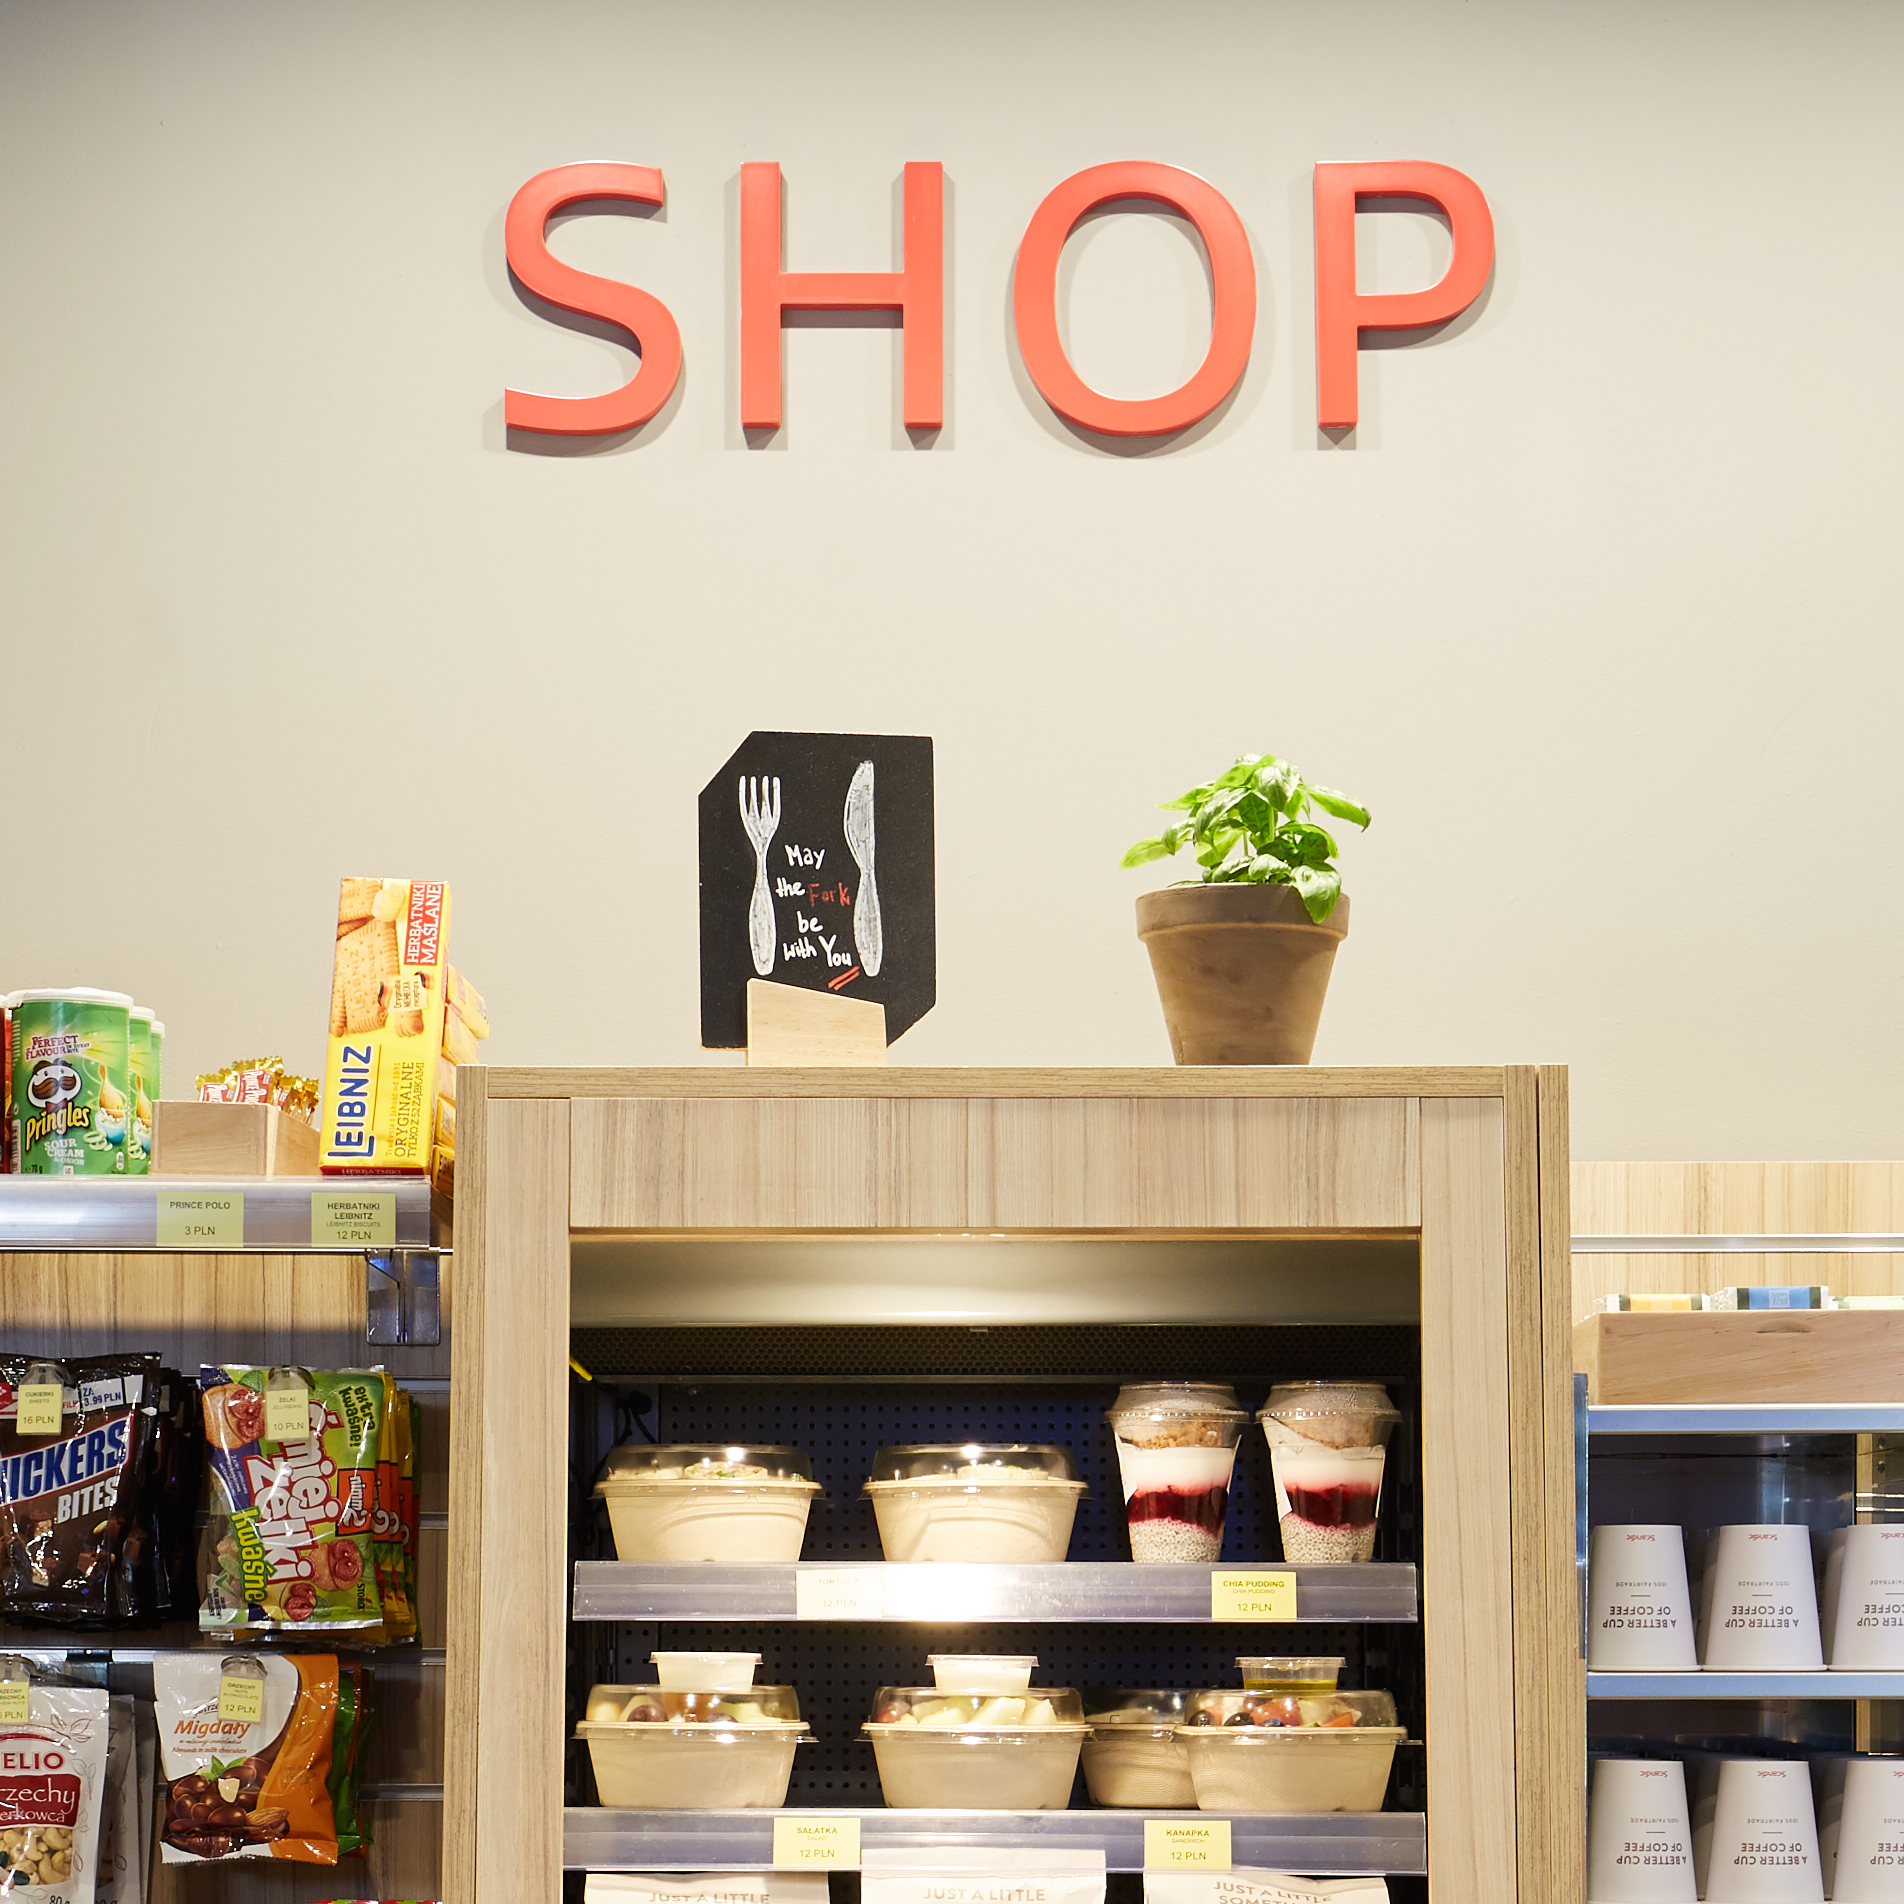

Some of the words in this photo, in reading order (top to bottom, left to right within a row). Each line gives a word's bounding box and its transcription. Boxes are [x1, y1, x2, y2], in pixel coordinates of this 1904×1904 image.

[504, 159, 1497, 438] SHOP
[784, 844, 826, 870] May
[775, 876, 806, 898] the
[807, 882, 851, 908] Fork
[406, 883, 426, 964] HERBATNIKI
[419, 883, 442, 964] MAŚLANE
[796, 910, 824, 934] be
[782, 936, 818, 961] with
[818, 934, 853, 968] You
[326, 1044, 376, 1159] LEIBNIZ
[394, 1061, 415, 1158] ORYGINALNE
[25, 1103, 91, 1152] Pringles
[44, 1138, 77, 1151] SOUR
[46, 1147, 85, 1158] CREAM
[169, 1201, 203, 1210] PRINCE
[205, 1201, 231, 1210] POLO
[327, 1202, 380, 1211] HERBATNIKI
[334, 1212, 373, 1221] LEIBNITZ
[184, 1225, 192, 1236] 3
[194, 1225, 216, 1236] PLN
[336, 1230, 348, 1240] 12
[350, 1230, 372, 1240] PLN
[56, 1476, 119, 1525] BITES
[229, 1507, 277, 1602] kwaśne
[1222, 1580, 1244, 1589] CHIA
[1246, 1580, 1285, 1589] PUDDING
[1236, 1602, 1248, 1613] 12
[1250, 1602, 1272, 1613] PLN
[1856, 1616, 1879, 1628] CUP
[173, 1719, 252, 1739] Migdały
[1165, 1828, 1210, 1838] KANAPKA
[1170, 1851, 1182, 1861] 12
[1184, 1851, 1207, 1861] PLN
[923, 1887, 966, 1901] JUST
[971, 1888, 984, 1901] A
[989, 1888, 1046, 1902] LITTLE
